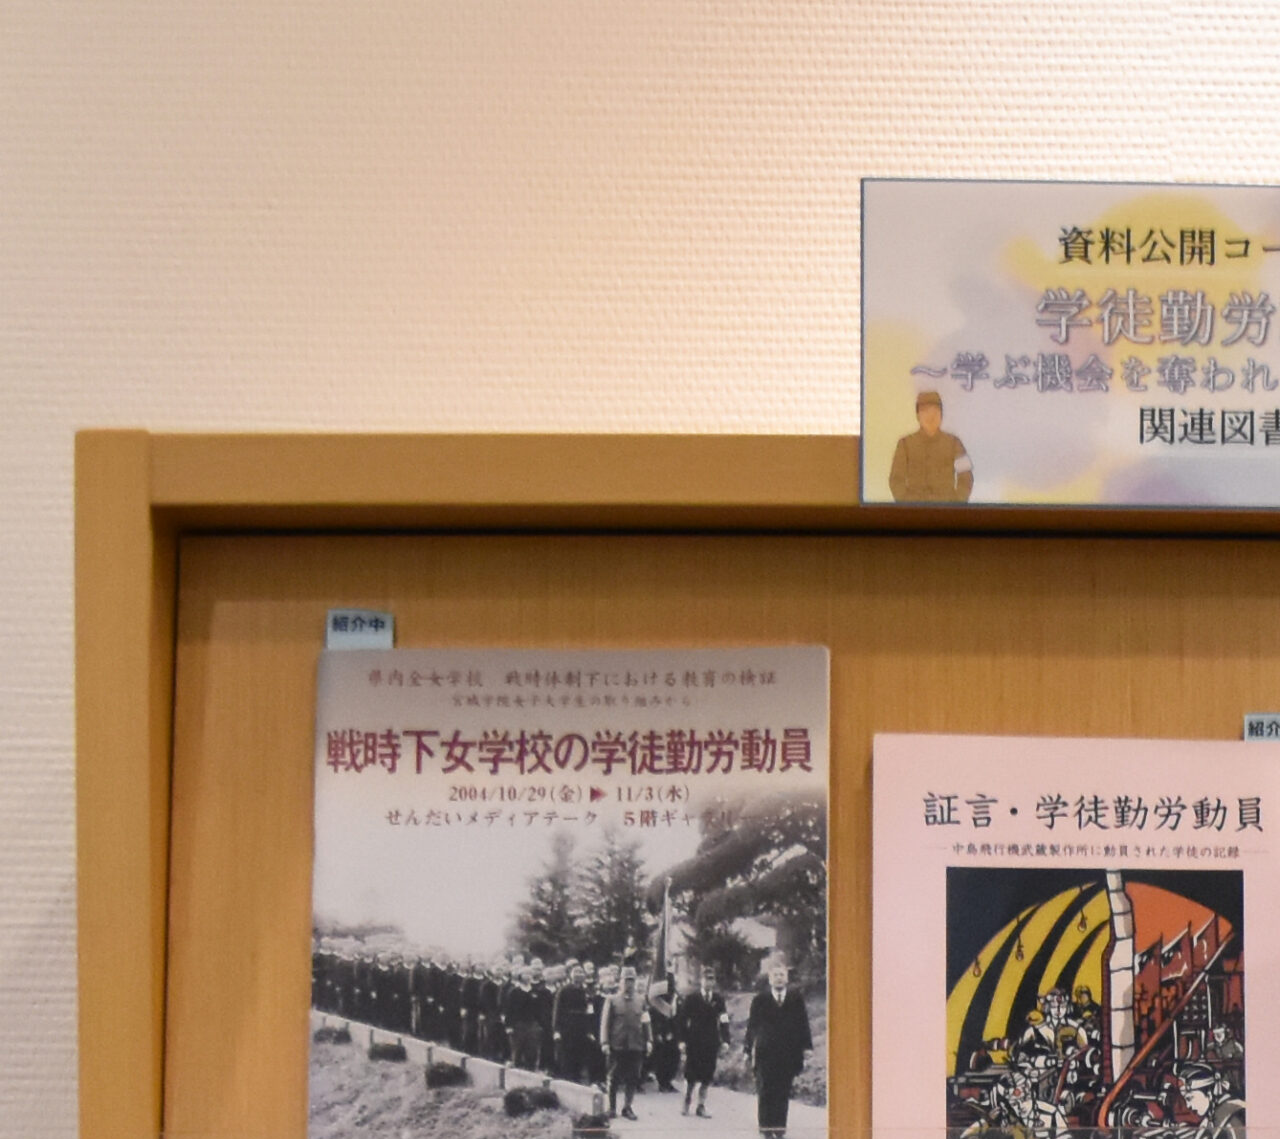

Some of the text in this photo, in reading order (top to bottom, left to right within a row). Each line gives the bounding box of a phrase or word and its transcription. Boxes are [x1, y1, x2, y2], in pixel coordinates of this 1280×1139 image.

[331, 615, 388, 634] 紹介中
[326, 728, 813, 775] 戦時下女学校の学徒勤労動員
[385, 808, 598, 828] せんだいメディアテーク
[922, 791, 1265, 832] 証言・学徒勤労動員
